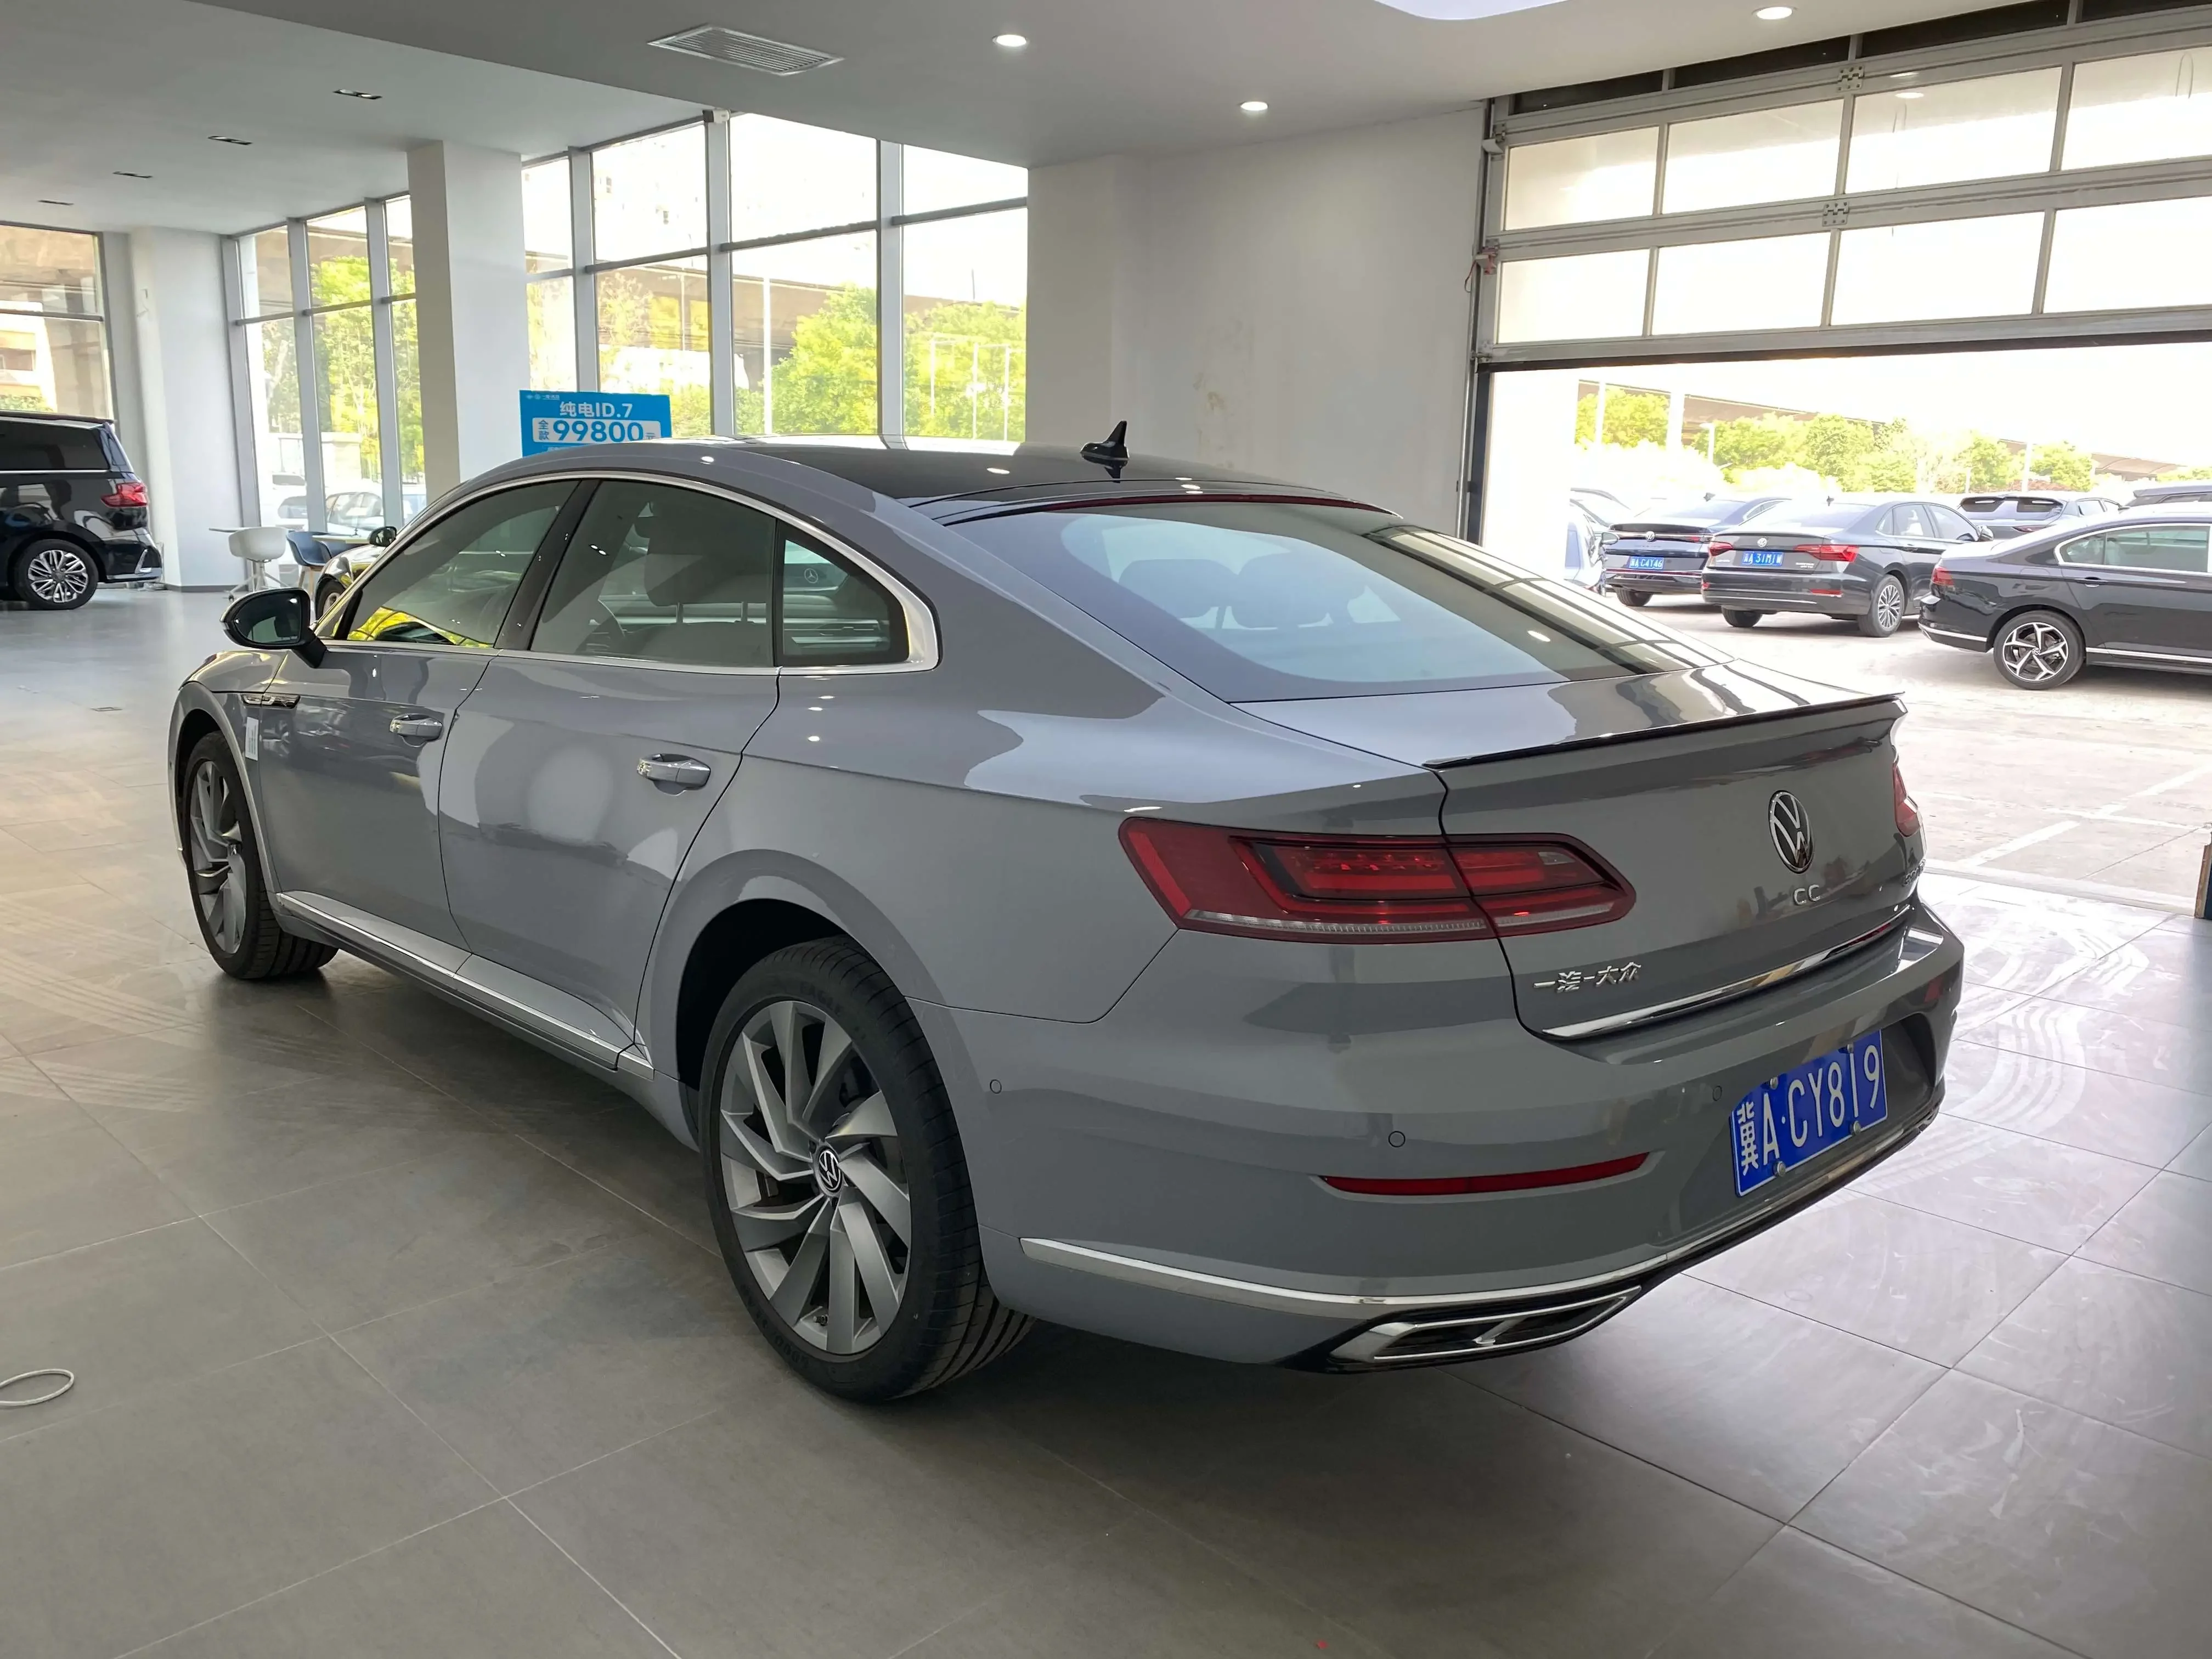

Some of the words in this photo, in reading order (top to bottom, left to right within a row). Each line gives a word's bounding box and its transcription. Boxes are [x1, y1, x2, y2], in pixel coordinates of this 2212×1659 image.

[560, 401, 633, 418] 纯电ID.7
[553, 420, 644, 442] 99800
[1793, 884, 1821, 905] CC
